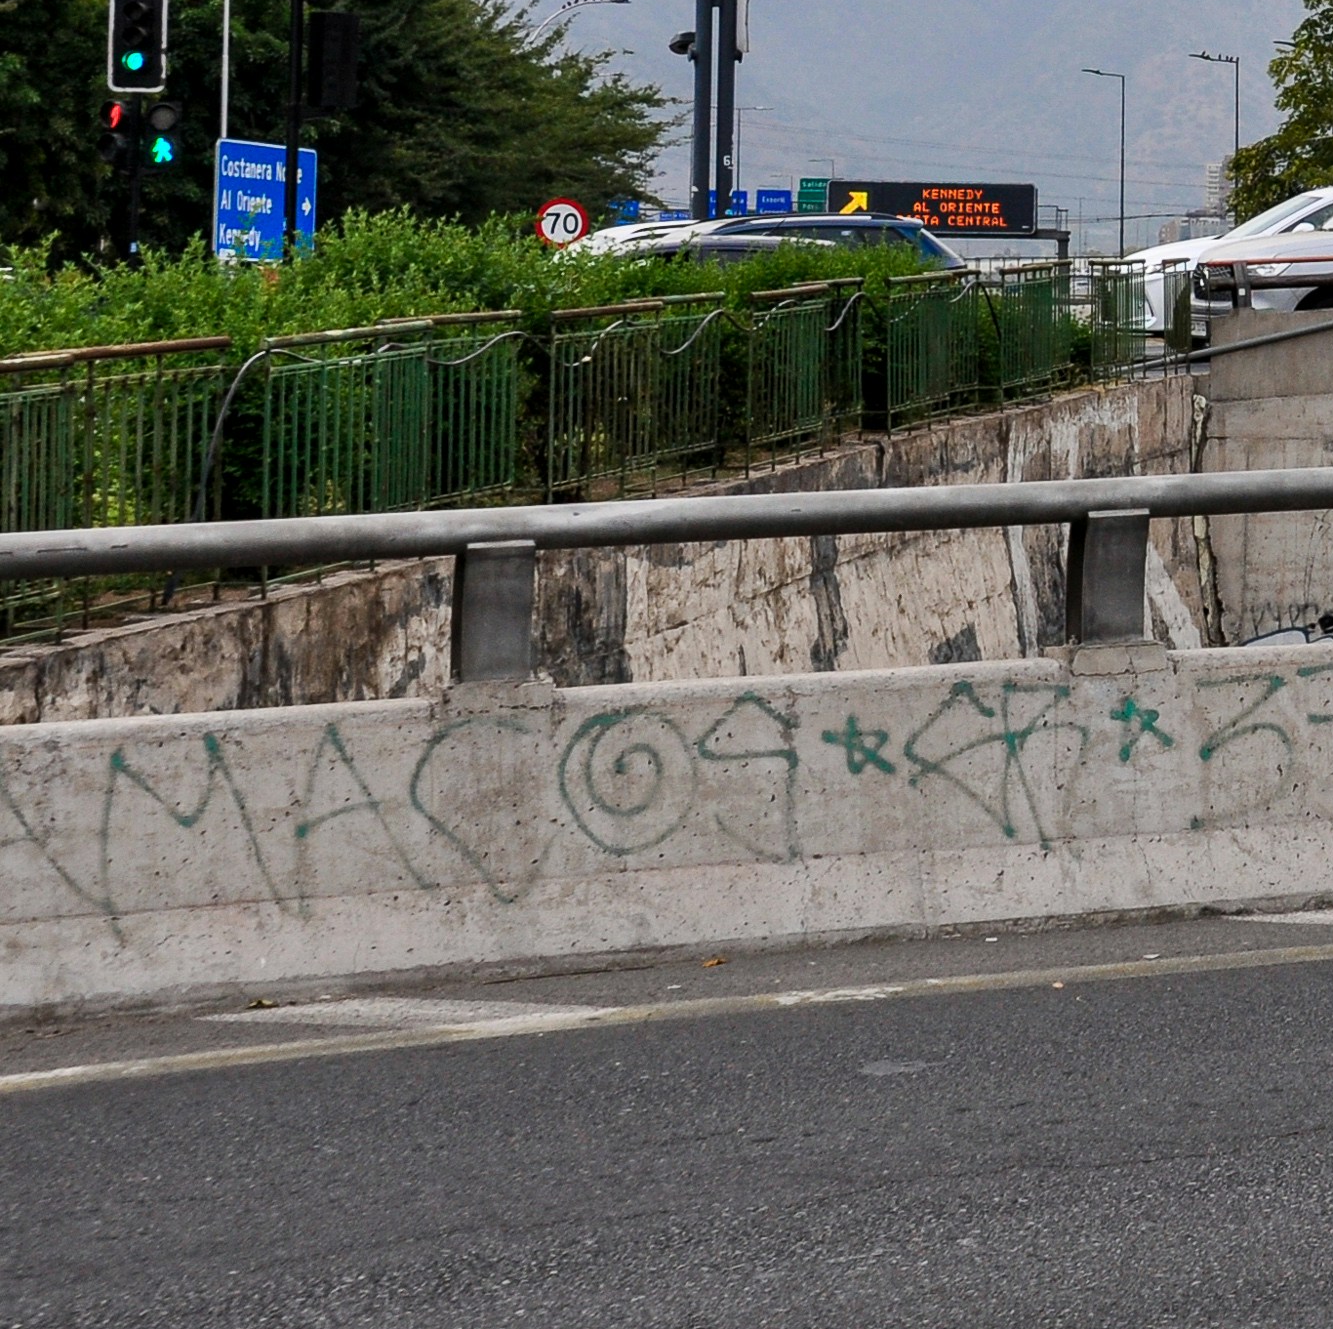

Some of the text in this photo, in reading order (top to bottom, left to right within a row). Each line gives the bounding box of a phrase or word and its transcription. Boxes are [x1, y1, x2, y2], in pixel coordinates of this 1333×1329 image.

[221, 154, 303, 185] Costanera Noe
[220, 188, 272, 215] Al Oriente
[922, 188, 984, 200] KENNEDY
[913, 202, 1000, 214] AL ORIENTE
[545, 212, 580, 235] 70
[948, 215, 1008, 227] CENTRAL
